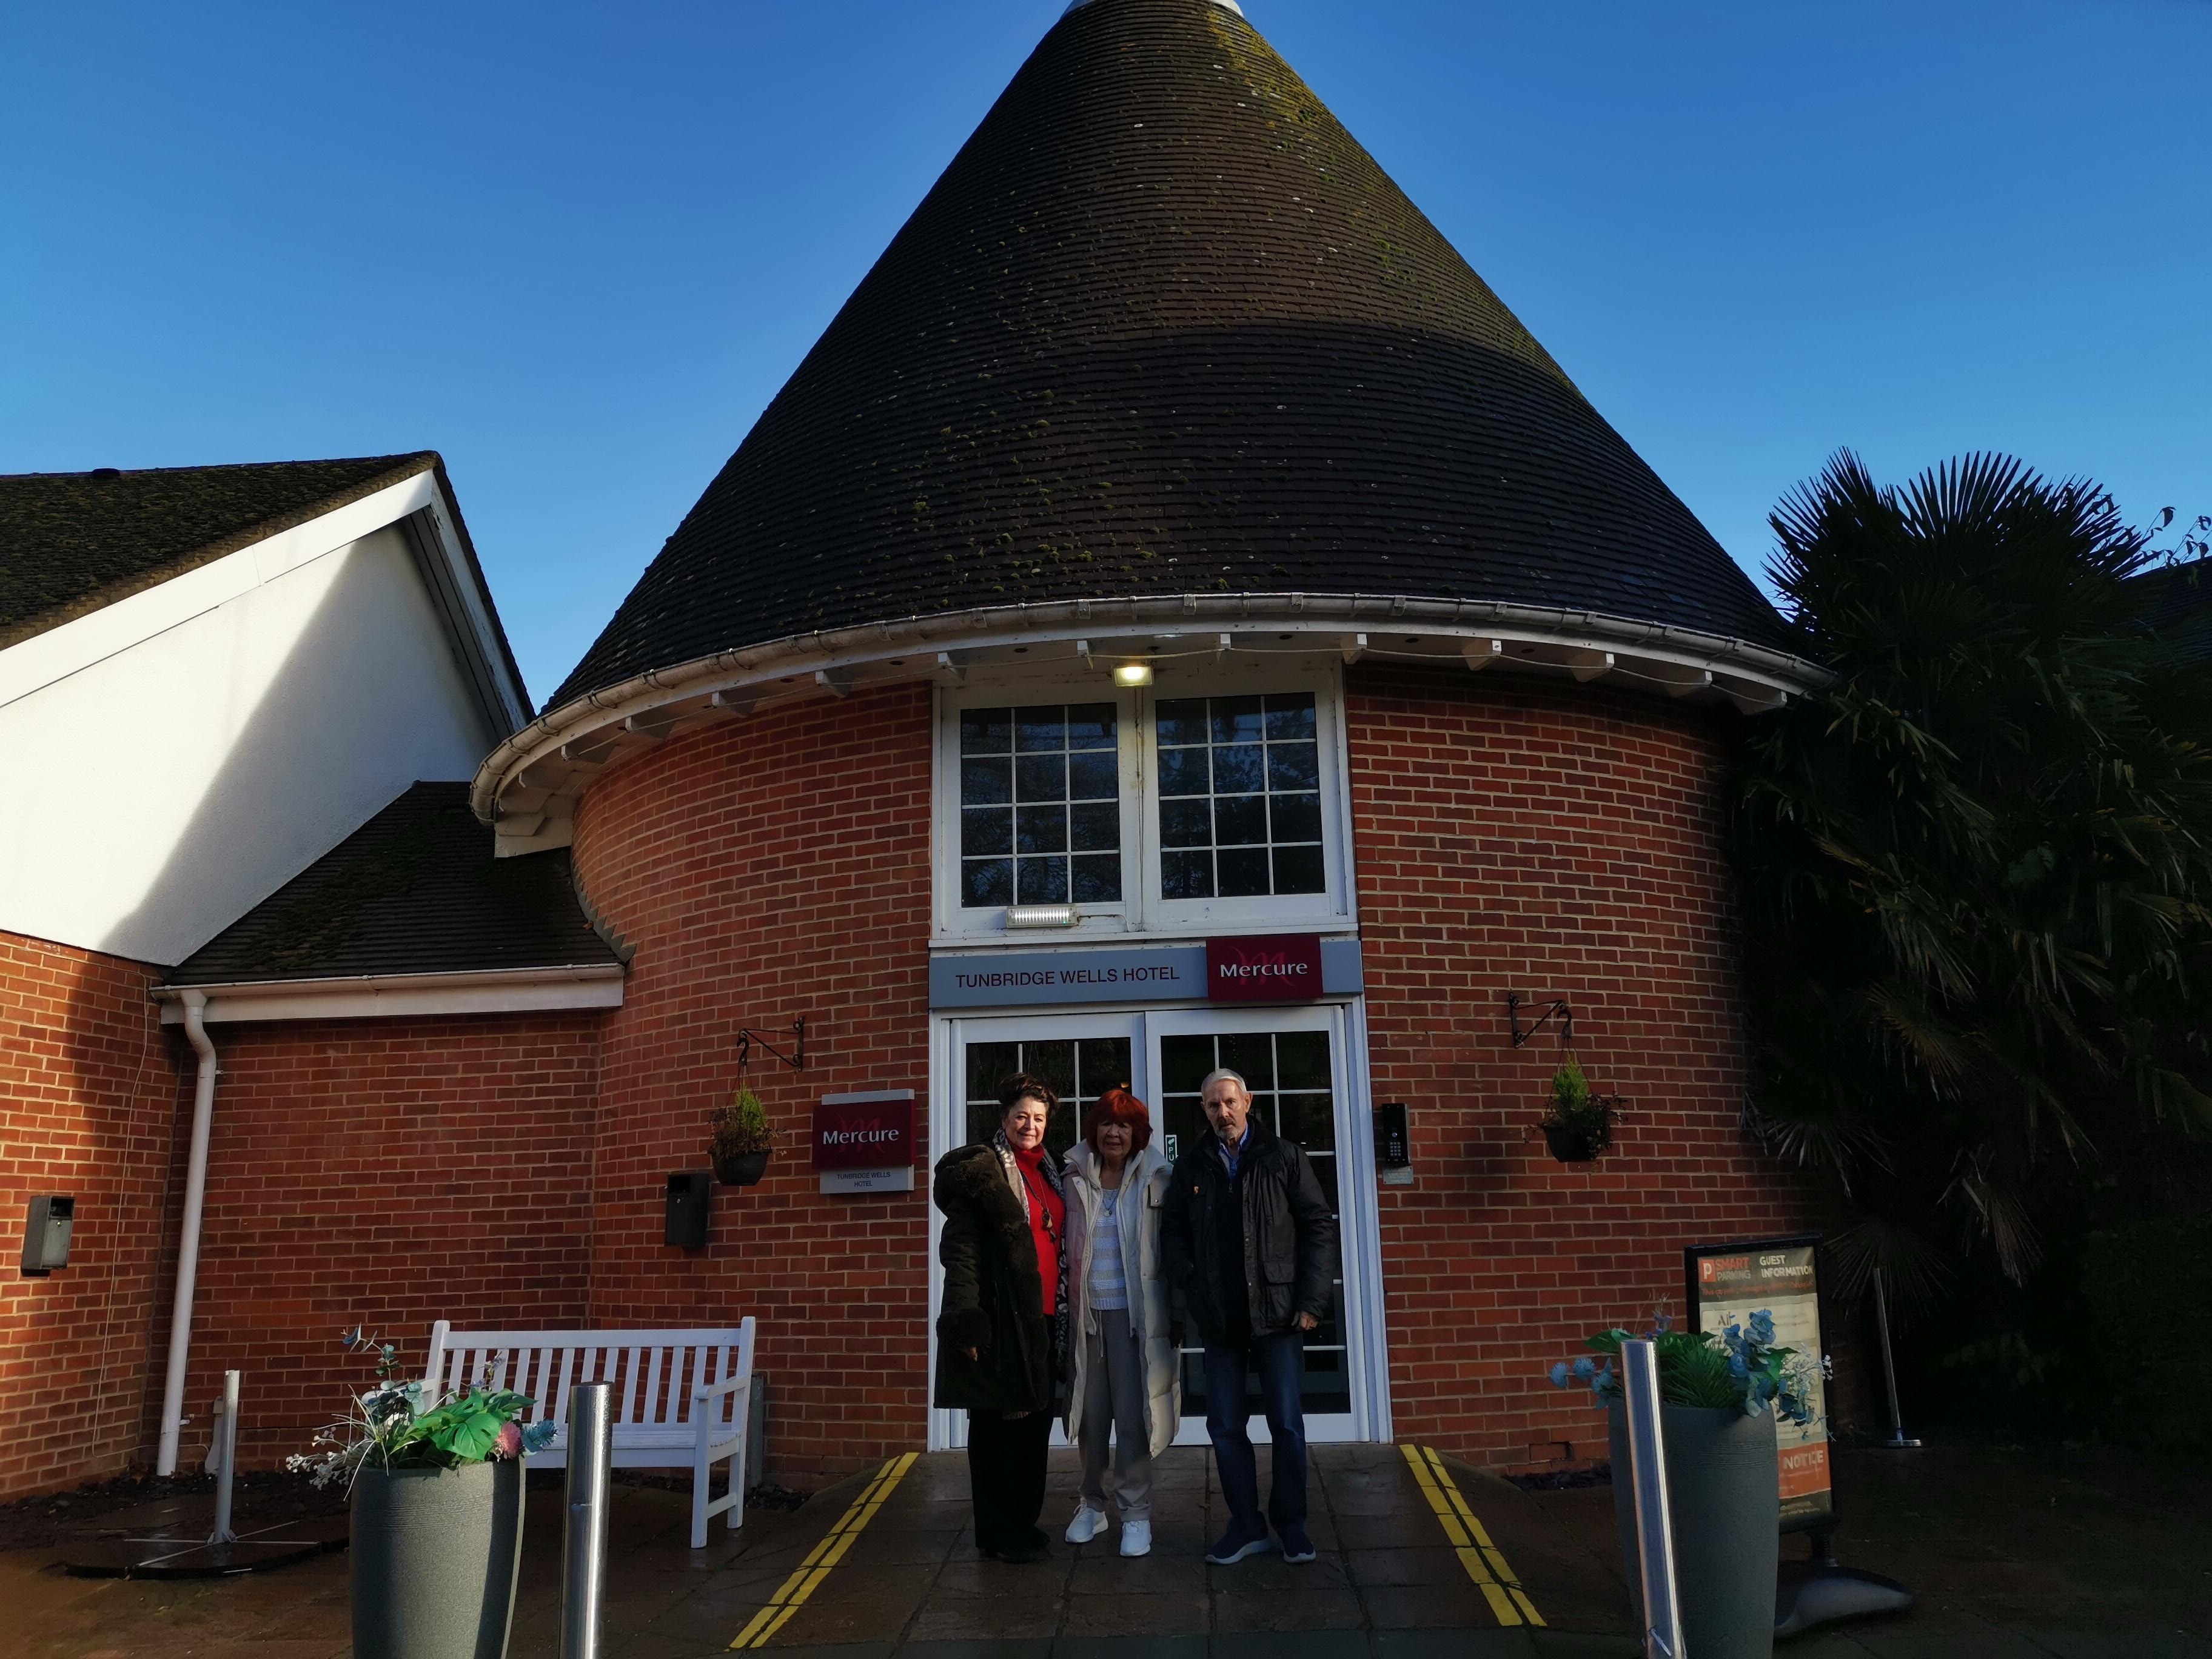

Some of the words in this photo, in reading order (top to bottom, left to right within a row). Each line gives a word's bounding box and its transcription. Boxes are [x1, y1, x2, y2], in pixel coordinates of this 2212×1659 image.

[1220, 962, 1309, 977] Mercure
[956, 971, 1055, 988] TUNBRIDGE
[1060, 968, 1118, 984] WELLS
[1123, 967, 1180, 981] HOTEL
[823, 1128, 899, 1145] Mercure
[1715, 1256, 1750, 1271] SMART
[1759, 1255, 1786, 1266] GUEST
[1703, 1262, 1712, 1279] P
[1717, 1269, 1751, 1281] PARKING
[1761, 1264, 1814, 1278] INFORMATION
[1783, 1450, 1824, 1470] NOTICE
